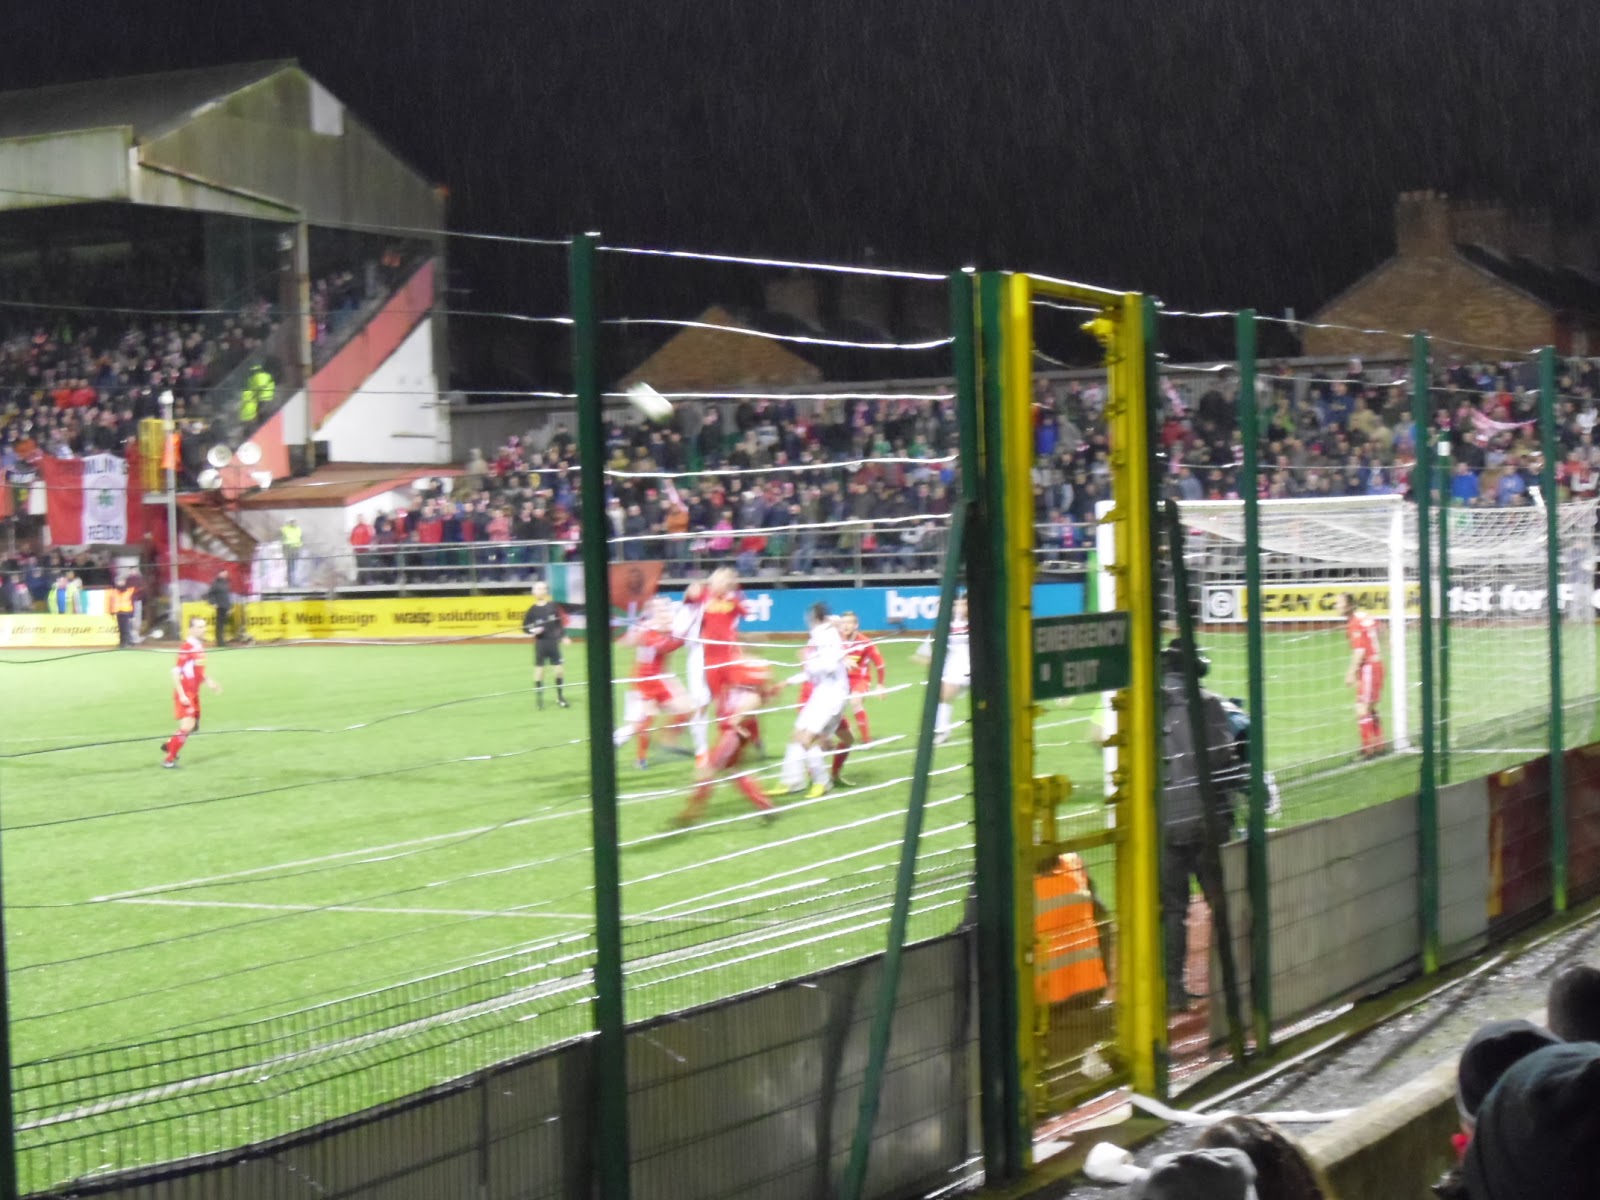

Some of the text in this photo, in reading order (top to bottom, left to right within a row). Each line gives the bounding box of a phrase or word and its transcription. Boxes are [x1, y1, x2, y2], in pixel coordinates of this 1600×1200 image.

[1447, 586, 1493, 612] 1st
[1500, 584, 1549, 611] for
[438, 609, 501, 622] solutions
[1034, 619, 1127, 654] EMERGENCY
[1062, 659, 1101, 688] EXIT
